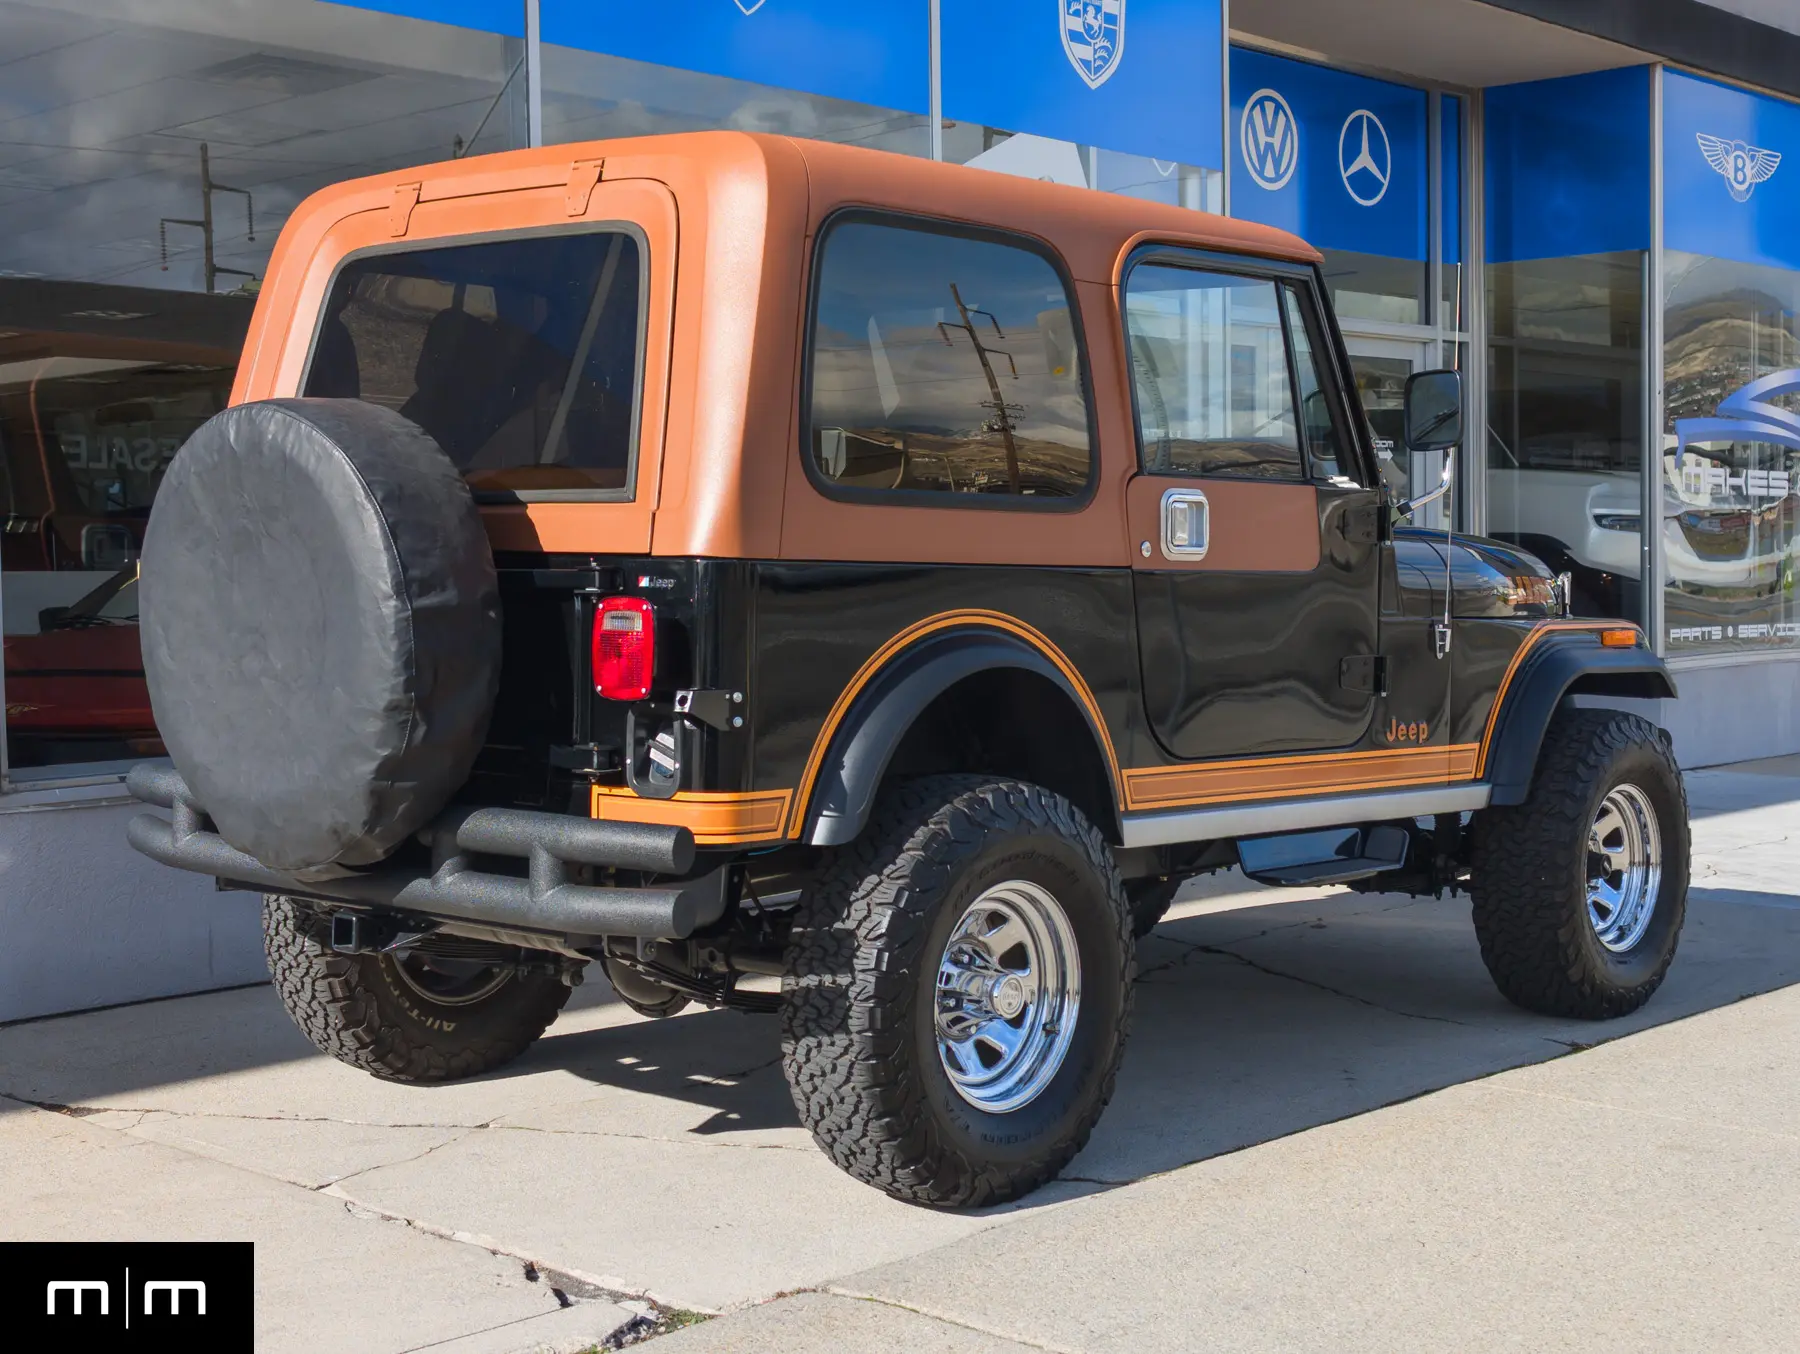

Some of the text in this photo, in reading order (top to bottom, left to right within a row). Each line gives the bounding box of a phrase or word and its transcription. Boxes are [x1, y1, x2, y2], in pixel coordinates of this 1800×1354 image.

[1733, 154, 1748, 186] B
[1683, 466, 1789, 497] MAKES
[650, 576, 676, 590] Jeep
[1669, 625, 1722, 643] PARTS
[1386, 717, 1428, 744] Jeep
